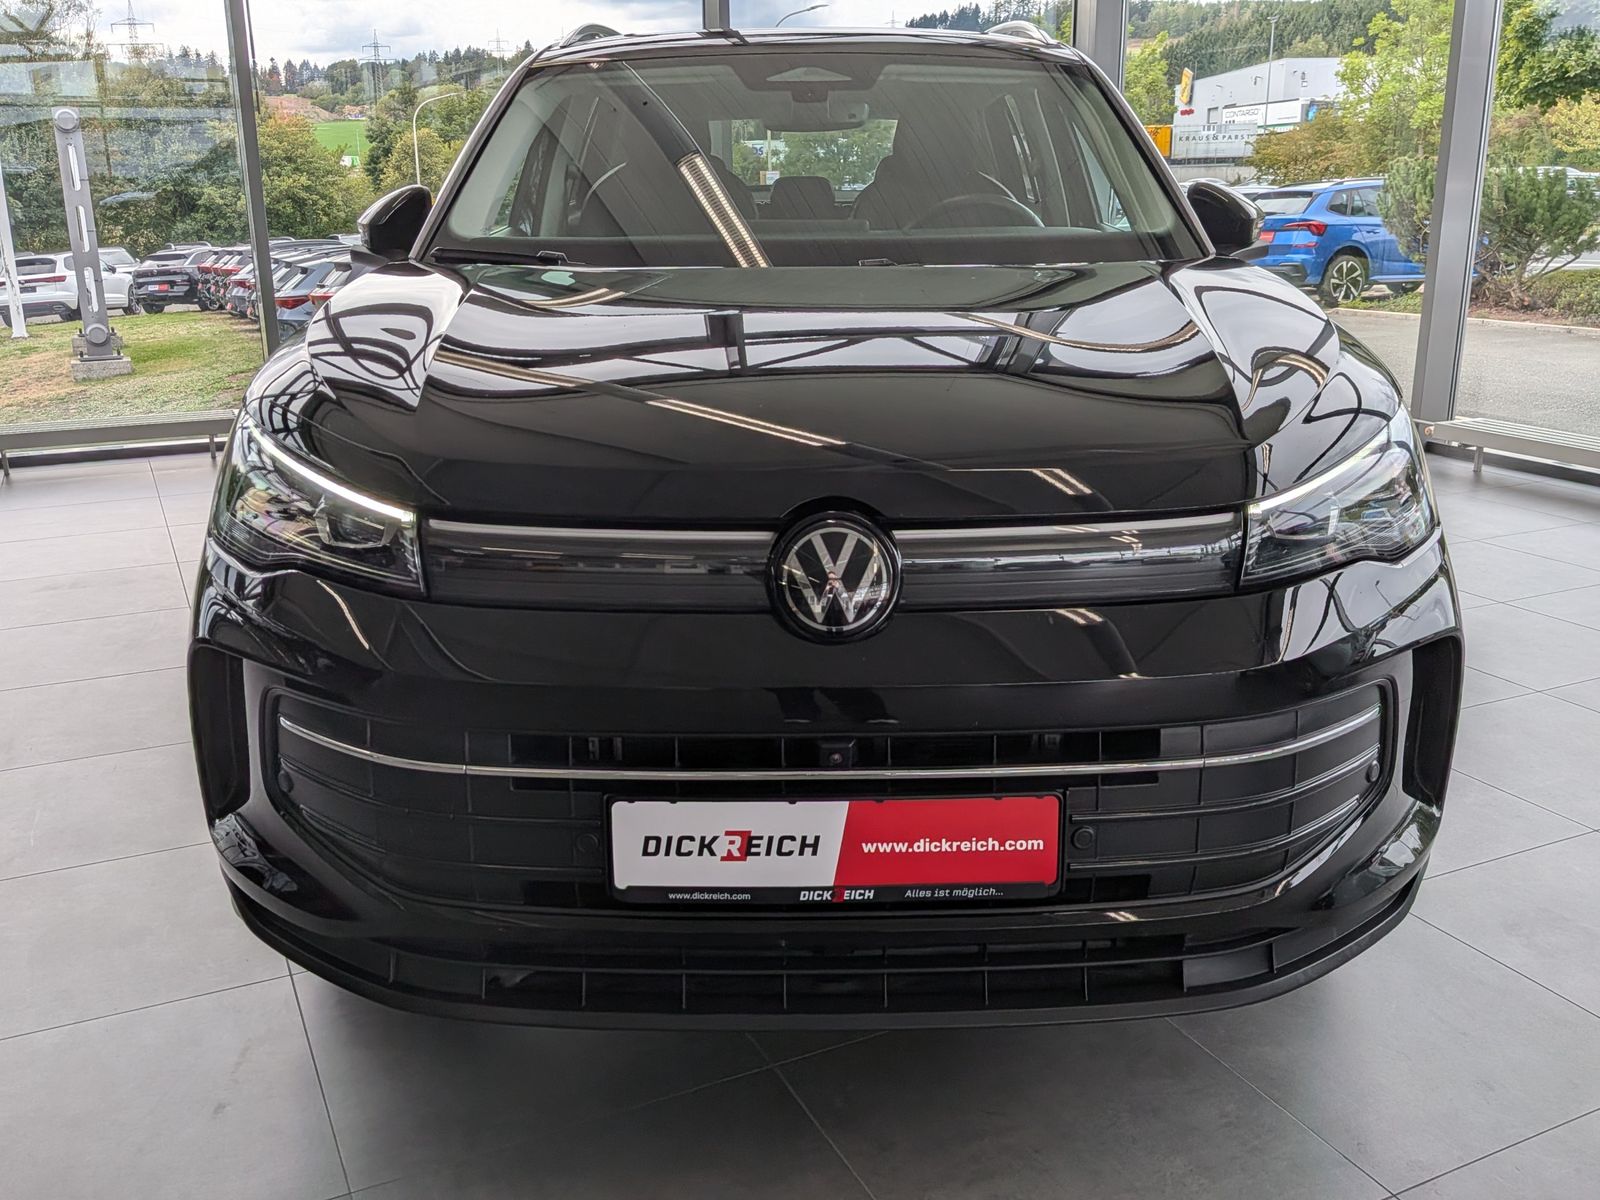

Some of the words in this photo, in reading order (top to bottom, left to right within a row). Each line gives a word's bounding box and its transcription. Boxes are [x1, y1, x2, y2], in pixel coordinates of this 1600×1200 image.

[1225, 108, 1259, 118] CONTARGO
[641, 830, 821, 861] DICKREICH
[862, 837, 1044, 853] www.dickreich.com
[668, 891, 751, 900] www.dickreich.com
[905, 889, 931, 898] Alles
[934, 888, 949, 897] ist
[952, 887, 1004, 898] möglich...
